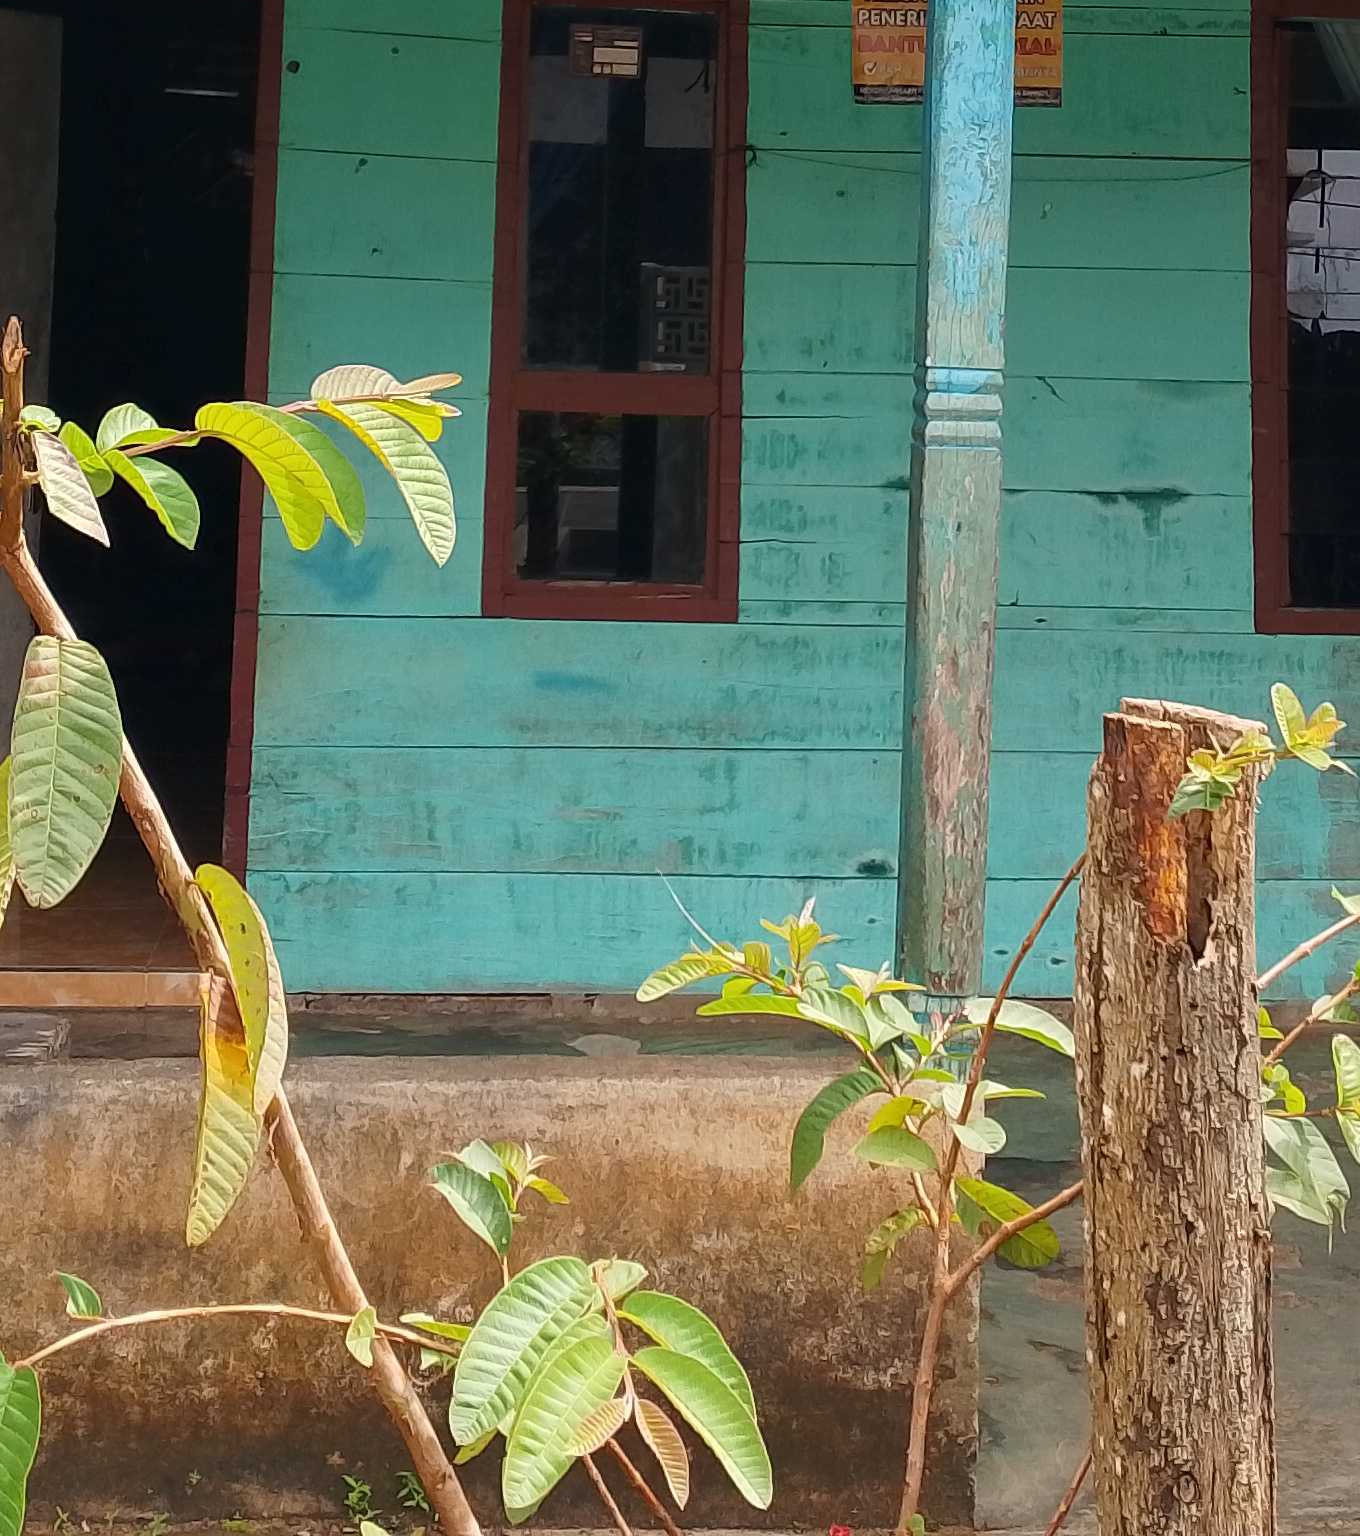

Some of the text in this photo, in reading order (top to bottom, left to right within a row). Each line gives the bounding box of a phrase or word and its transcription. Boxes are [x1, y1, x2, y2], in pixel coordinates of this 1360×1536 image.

[857, 8, 1057, 29] PENERI AAT
[1018, 37, 1057, 55] IAL
